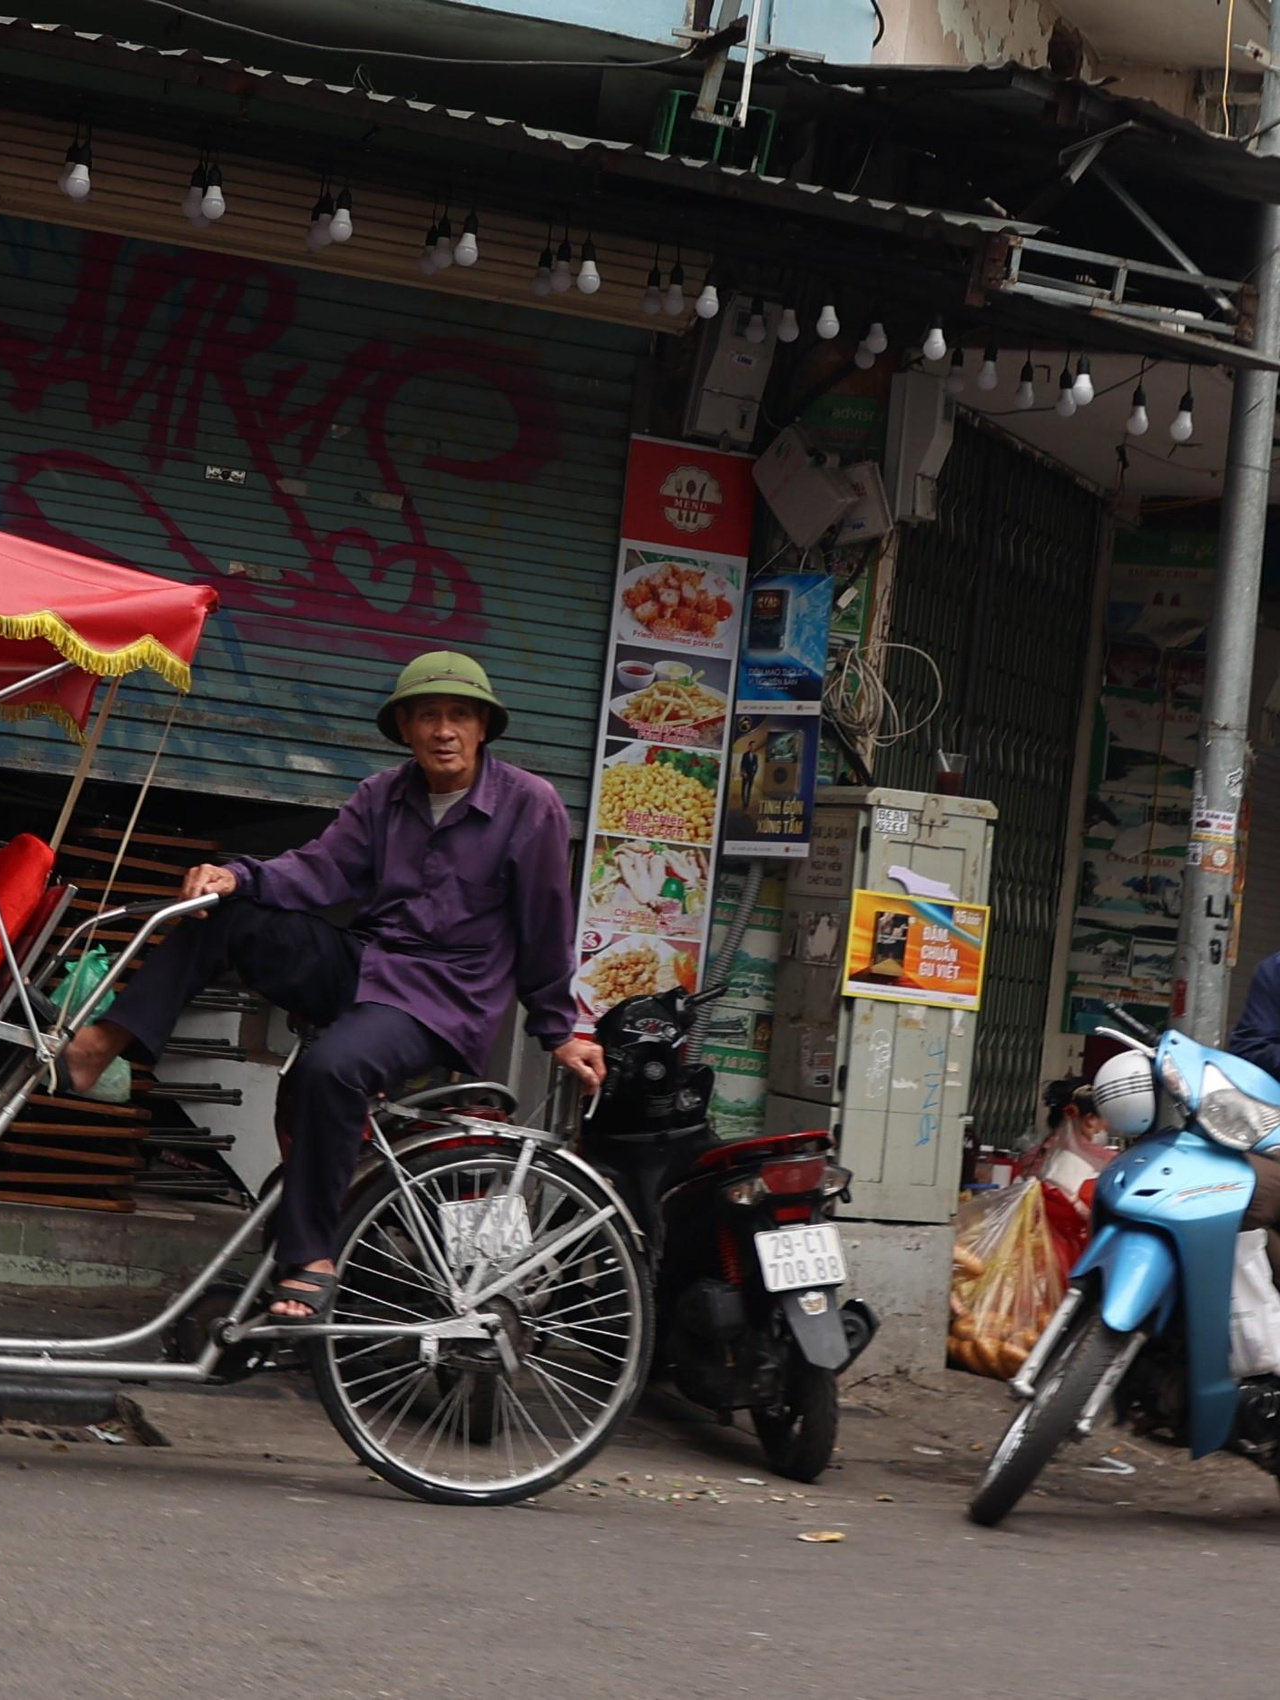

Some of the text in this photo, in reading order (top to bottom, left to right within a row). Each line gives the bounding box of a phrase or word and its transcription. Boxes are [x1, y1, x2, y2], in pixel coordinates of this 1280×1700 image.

[673, 497, 708, 512] MENU
[659, 826, 685, 837] corn
[769, 1231, 828, 1260] 29-C1
[768, 1256, 840, 1288] 708.88
